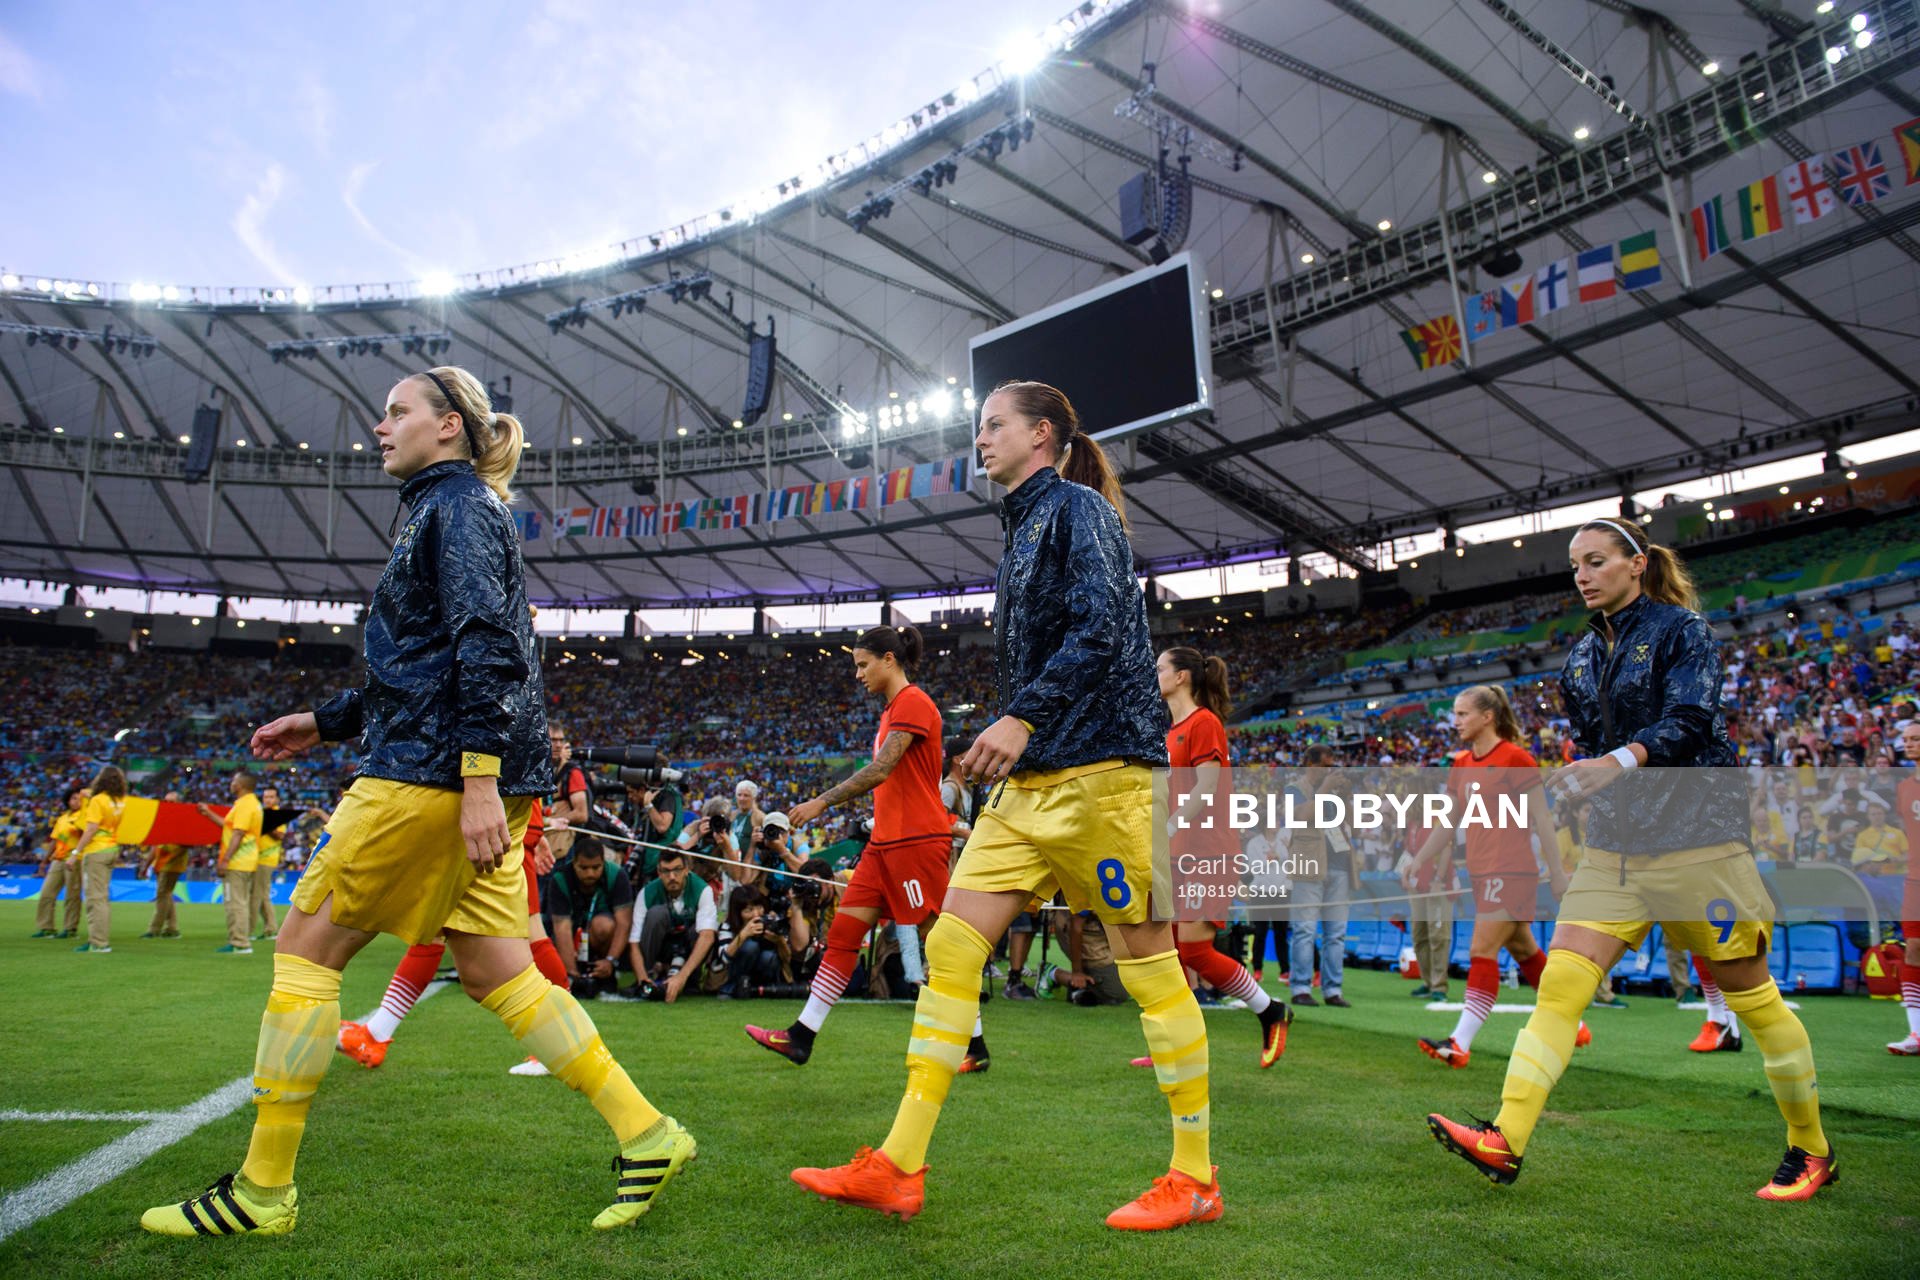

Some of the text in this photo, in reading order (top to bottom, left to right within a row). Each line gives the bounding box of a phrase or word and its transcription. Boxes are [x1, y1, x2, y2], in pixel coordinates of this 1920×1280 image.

[902, 879, 924, 909] 10
[1096, 858, 1132, 910] 8
[1483, 878, 1504, 903] 12
[1705, 898, 1737, 945] 9
